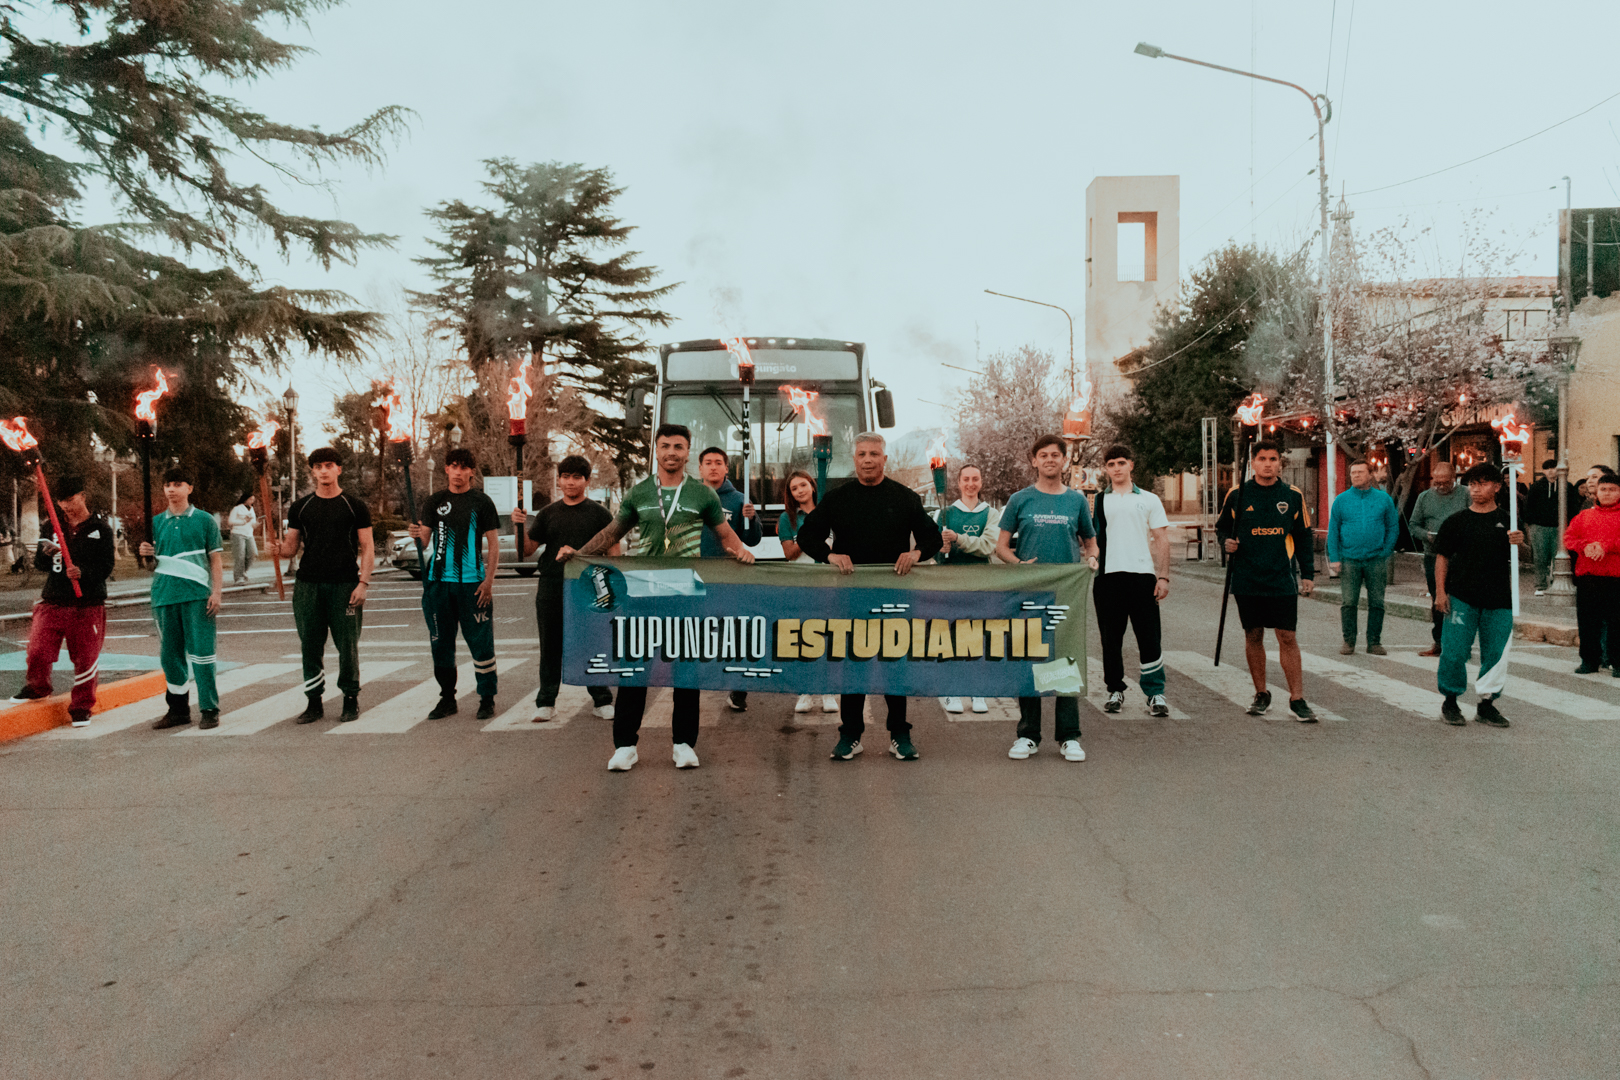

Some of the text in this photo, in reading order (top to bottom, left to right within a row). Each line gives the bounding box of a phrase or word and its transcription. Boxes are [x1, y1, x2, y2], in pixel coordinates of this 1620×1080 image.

[473, 611, 490, 623] VK
[614, 616, 1049, 659] TUPUNGATO ESTUDIANTIL
